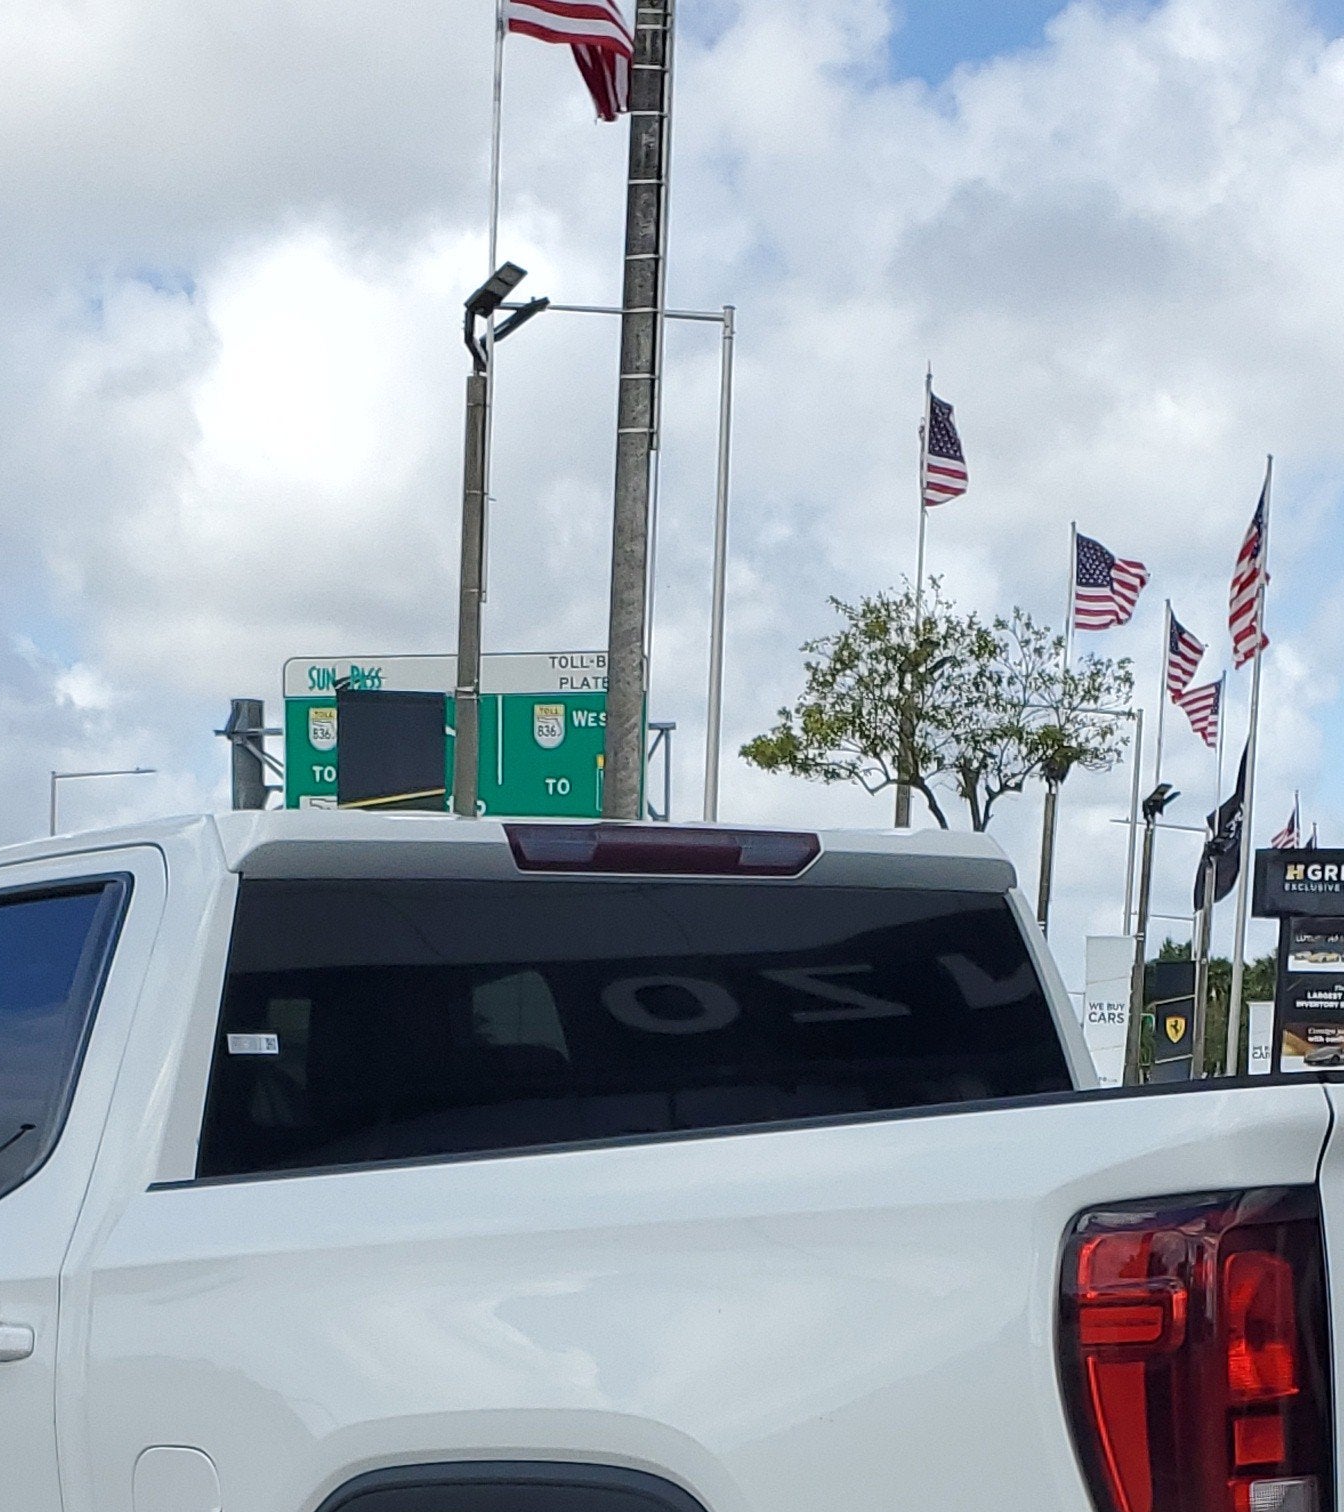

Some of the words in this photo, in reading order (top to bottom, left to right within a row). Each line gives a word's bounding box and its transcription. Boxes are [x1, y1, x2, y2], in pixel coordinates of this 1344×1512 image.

[549, 656, 607, 669] TOLL-B
[539, 707, 559, 716] TOLL
[537, 725, 556, 738] 836
[572, 709, 607, 728] WES
[312, 765, 337, 783] TO
[545, 777, 570, 796] TO
[1283, 882, 1341, 893] EXCLUSIVE
[1089, 1002, 1104, 1011] WE
[1106, 1002, 1125, 1012] BUY
[1088, 1012, 1125, 1024] CARS
